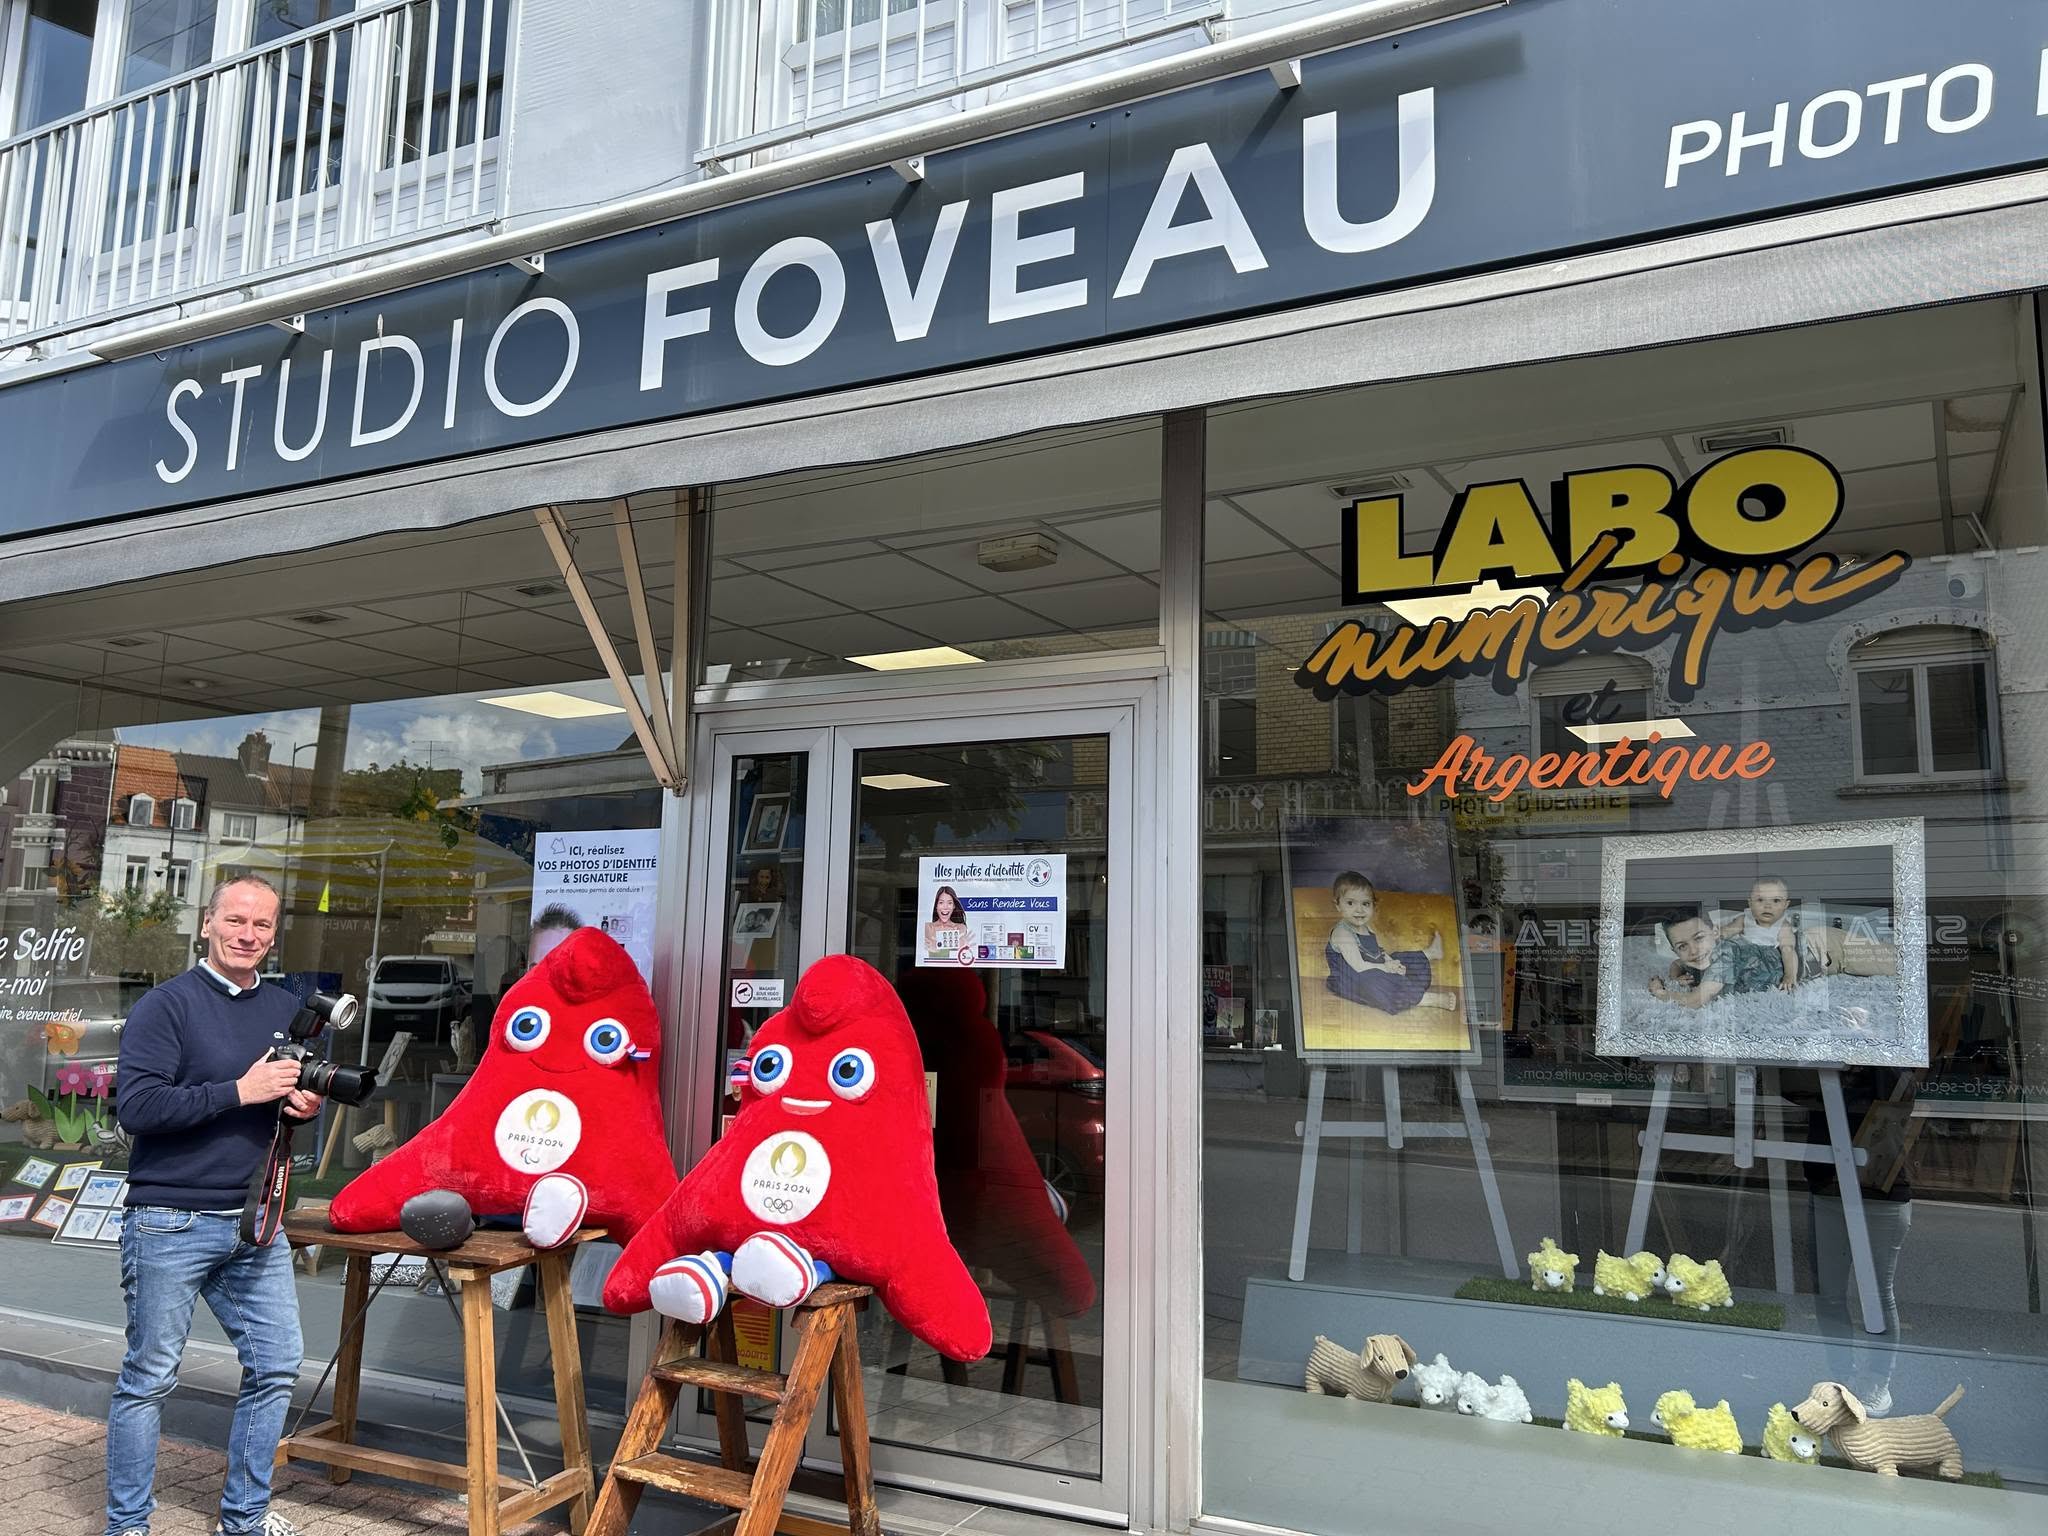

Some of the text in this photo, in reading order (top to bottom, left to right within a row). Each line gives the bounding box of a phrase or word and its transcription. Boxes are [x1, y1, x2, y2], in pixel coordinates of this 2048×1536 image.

[1664, 63, 1993, 189] PHOTO
[155, 86, 1438, 485] STUDIO FOVEAU
[1343, 445, 1844, 603] LABO
[1297, 534, 1911, 698] numérique
[1562, 680, 1621, 725] et
[1407, 731, 1776, 801] Argentique
[569, 845, 625, 857] ICI, réalisez
[538, 855, 657, 871] VOS PHOTOS D'IDENTITÉ
[934, 863, 952, 878] Mes
[955, 863, 982, 880] photos
[984, 862, 1025, 876] d'identité
[563, 873, 628, 884] & SIGNATURE
[966, 897, 1050, 909] Sans Rendez Vous
[1028, 925, 1039, 933] CV
[13, 926, 85, 961] Selfie
[0, 1005, 14, 1021] ire,
[537, 1137, 565, 1149] 2024
[273, 1166, 285, 1198] Canon
[783, 1183, 812, 1195] 2024
